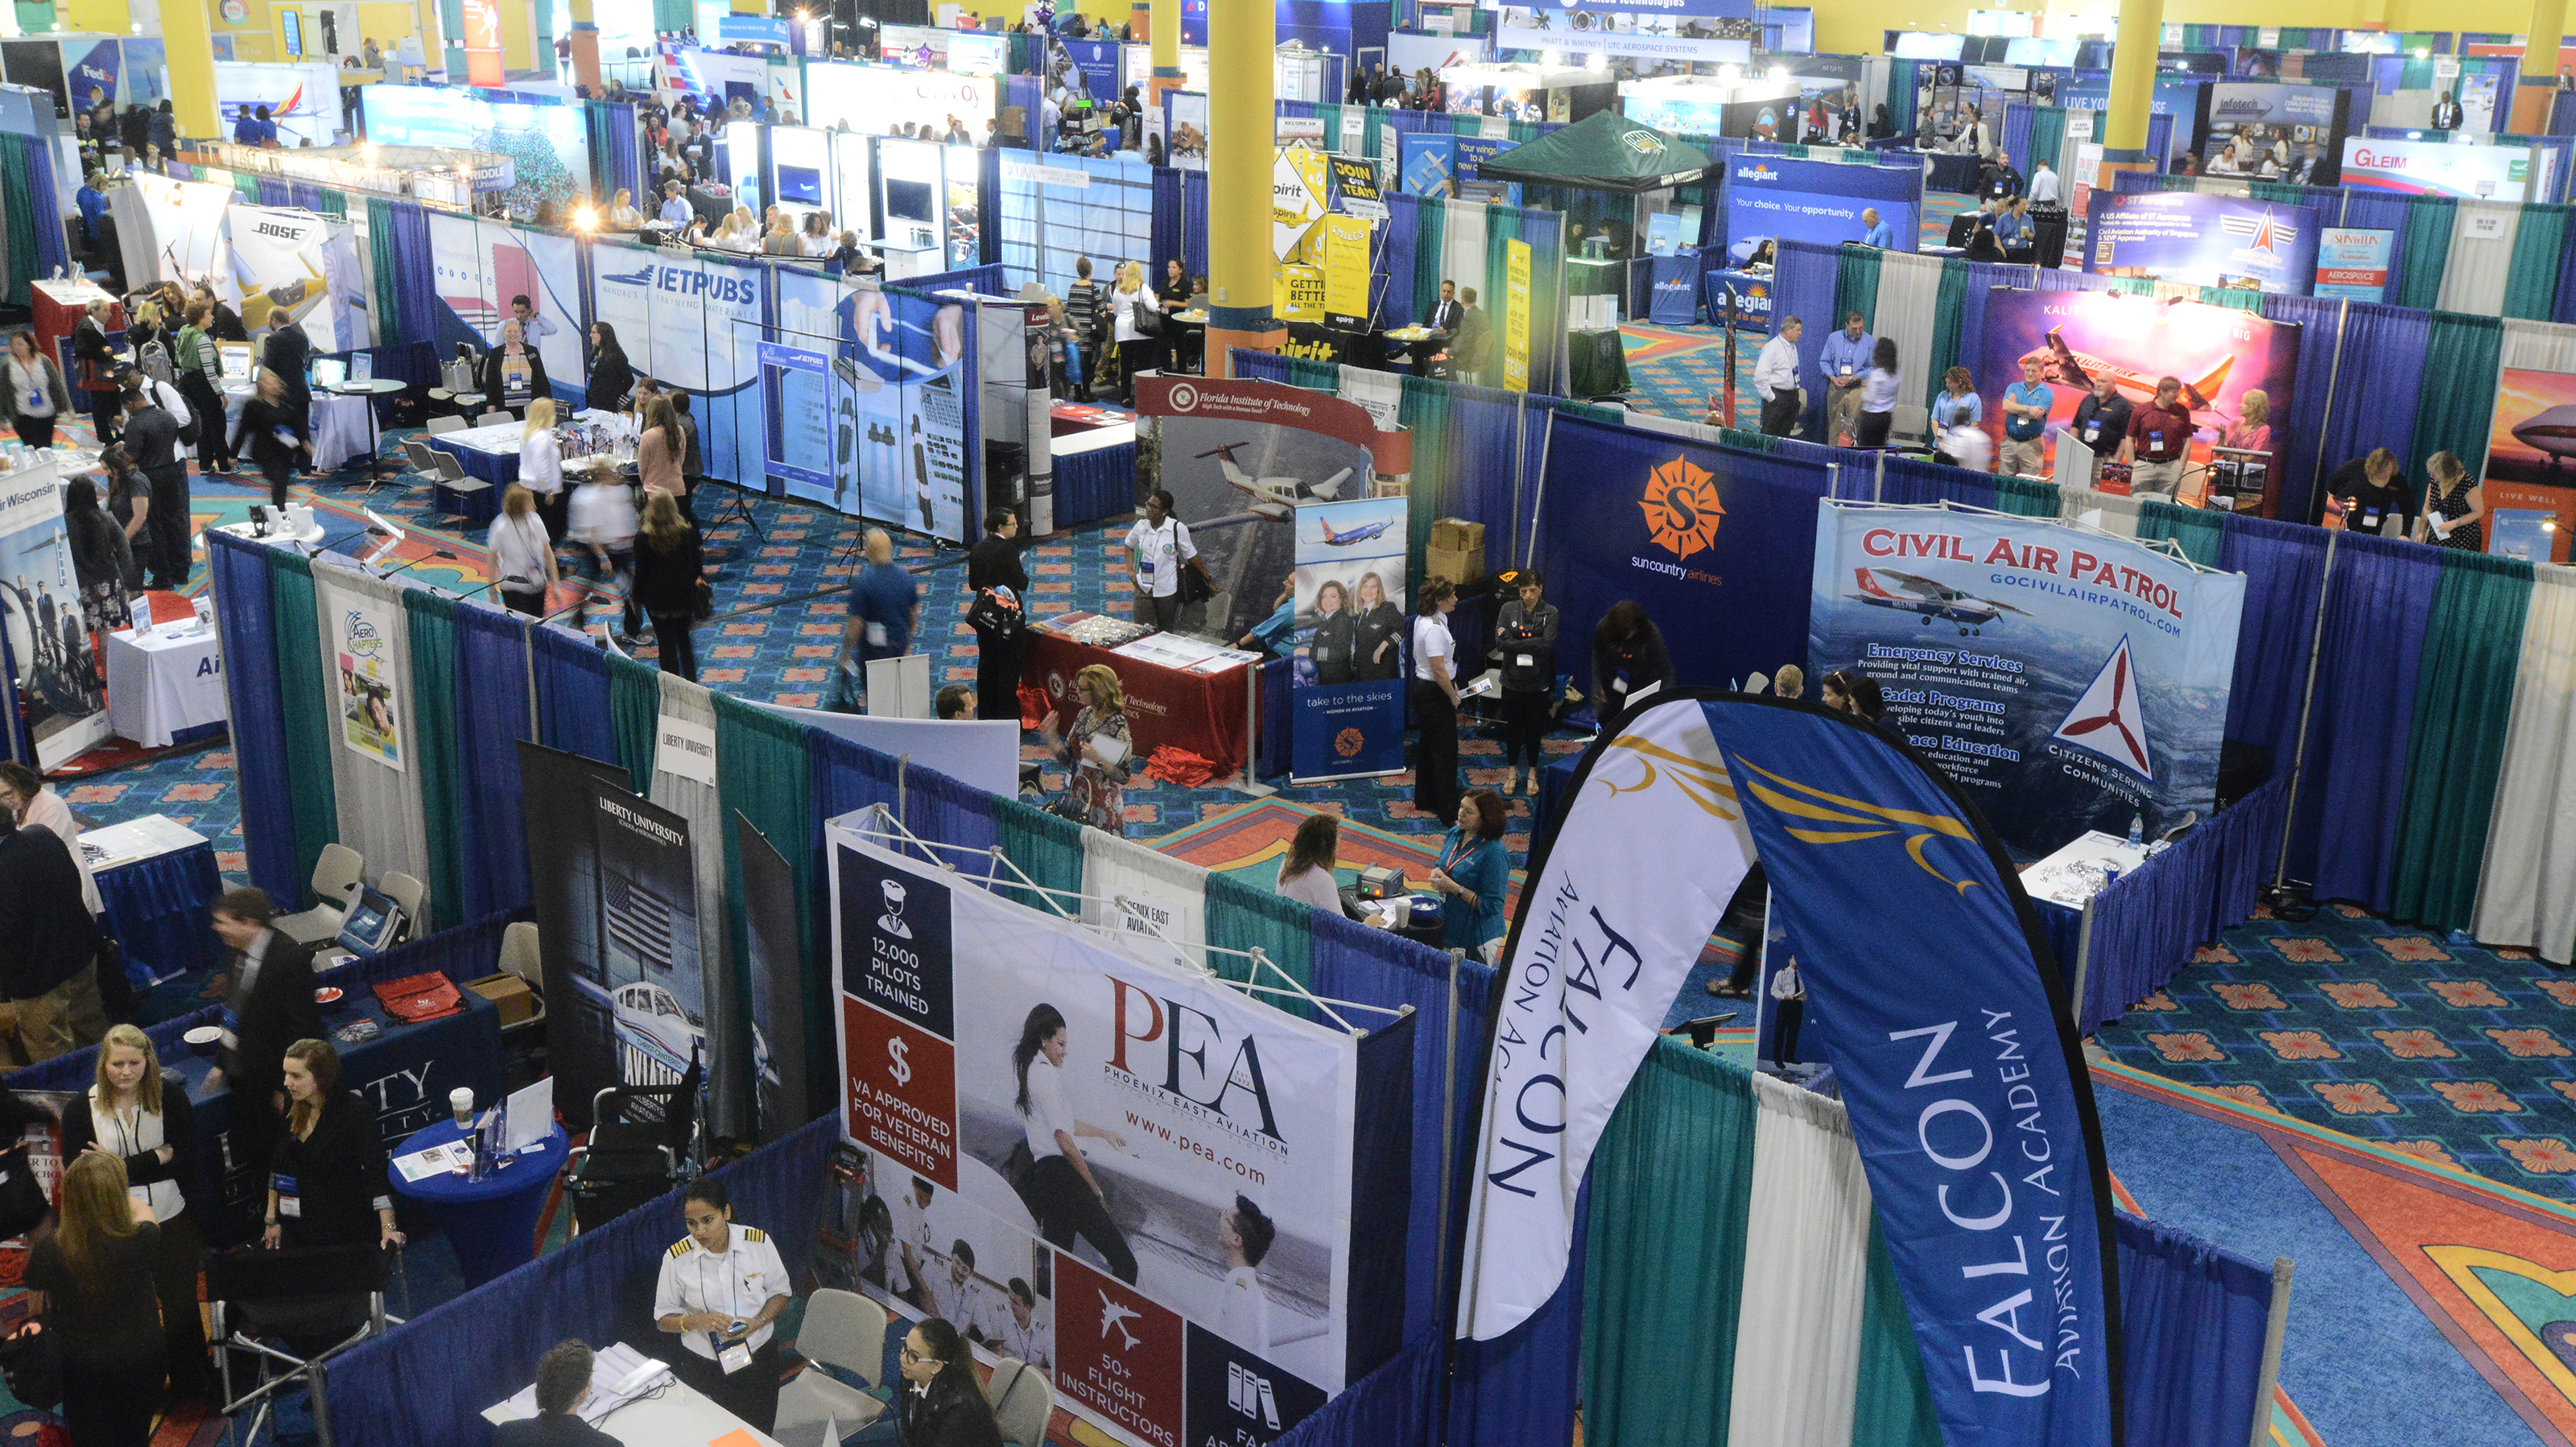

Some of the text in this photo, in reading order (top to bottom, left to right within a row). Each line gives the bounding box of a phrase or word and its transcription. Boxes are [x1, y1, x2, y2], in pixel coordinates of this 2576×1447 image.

[1542, 37, 1562, 46] PRATT
[1571, 39, 1601, 48] WHITNEY
[1608, 43, 1698, 55] UTC AEROSPACE SYSTEMS
[82, 64, 114, 83] FedEx
[2065, 96, 2088, 109] LIVE
[2220, 98, 2258, 110] infotech
[1459, 142, 1497, 157] Your wings
[1470, 153, 1477, 162] to
[2355, 148, 2408, 169] GLEIM
[1015, 166, 1036, 179] UAA
[1334, 162, 1371, 181] JOIN
[1458, 162, 1472, 171] new
[1737, 167, 1778, 181] allegiant
[1343, 183, 1378, 200] TEAM!
[1348, 176, 1365, 187] OUR
[1736, 197, 1855, 220] Your choice. Your opportunity.
[2157, 215, 2191, 223] Aerospace
[252, 222, 306, 241] BOSE
[2135, 229, 2161, 237] Authority
[2169, 230, 2199, 238] Singapore
[656, 266, 756, 305] JETPUBS
[1654, 279, 1690, 291] allegiant
[602, 286, 756, 319] MANUALS TRAINING MATERIALS
[1335, 315, 1355, 325] spirit
[2232, 327, 2251, 341] BIG
[801, 354, 824, 365] JETPUBS
[1199, 393, 1311, 417] Florida Institute of Technology
[6, 482, 56, 508] Wisconsin
[2500, 491, 2557, 505] LIVE WELL
[1687, 567, 1723, 587] airlines
[1862, 528, 2184, 621] CIVIL AIR PATROL
[1990, 573, 2182, 639] GOCIVILAIRPATROL.COM
[353, 624, 374, 639] AERO
[347, 637, 383, 653] CHAPTERS
[1868, 643, 2024, 674] Emergency Services
[1858, 659, 2029, 687] Providing vital support with trained air,
[1901, 671, 1918, 681] and
[1919, 674, 1992, 690] communications
[1992, 683, 2019, 695] teams
[1129, 695, 1168, 715] Technology
[1307, 691, 1392, 707] take to the skies
[1880, 687, 2006, 715] Cadet Programs
[1920, 716, 1954, 728] citizens
[1955, 720, 1972, 731] and
[1974, 723, 2005, 736] leaders
[1925, 707, 1957, 719] today's
[1959, 711, 1985, 724] youth
[1987, 715, 2005, 726] into
[663, 732, 713, 760] LIBERTY UNIVERSITY
[1942, 735, 2021, 762] Education
[1928, 750, 1990, 767] education and
[1961, 775, 2003, 789] programs
[2049, 743, 2154, 801] CITIZENS SERVING
[2062, 764, 2141, 808] COMMUNITIES
[599, 794, 684, 847] LIBERTY UNIVERSITY
[618, 818, 635, 831] SCHOOL
[638, 827, 667, 847] AERONAUTICS
[1151, 909, 1170, 927] EAST
[872, 936, 919, 968] 12,000
[1513, 868, 1580, 1014] AVIATION
[872, 955, 923, 991] PILOTS
[865, 975, 929, 1016] TRAINED
[636, 1038, 682, 1070] CHRIST-CENTERED
[1104, 974, 1288, 1144] PEA
[1487, 903, 1643, 1200] FALCON
[852, 1076, 950, 1138] VA APPROVED
[1104, 1066, 1288, 1156] PHOENIX EAST AVIATION
[853, 1096, 952, 1160] FOR VETERAN
[1104, 1078, 1161, 1107] DAYTONA
[1228, 1133, 1288, 1166] FLORIDA
[870, 1124, 936, 1173] BENEFITS
[1125, 1109, 1266, 1187] www.pea.com
[42, 1158, 59, 1168] TO
[1980, 1005, 2080, 1380] AVIATION ACADEMY
[1889, 1020, 2051, 1399] FALCON
[1102, 1353, 1133, 1379] 50+
[1088, 1366, 1147, 1410] FLIGHT
[1062, 1371, 1174, 1447] INSTRUCTORS
